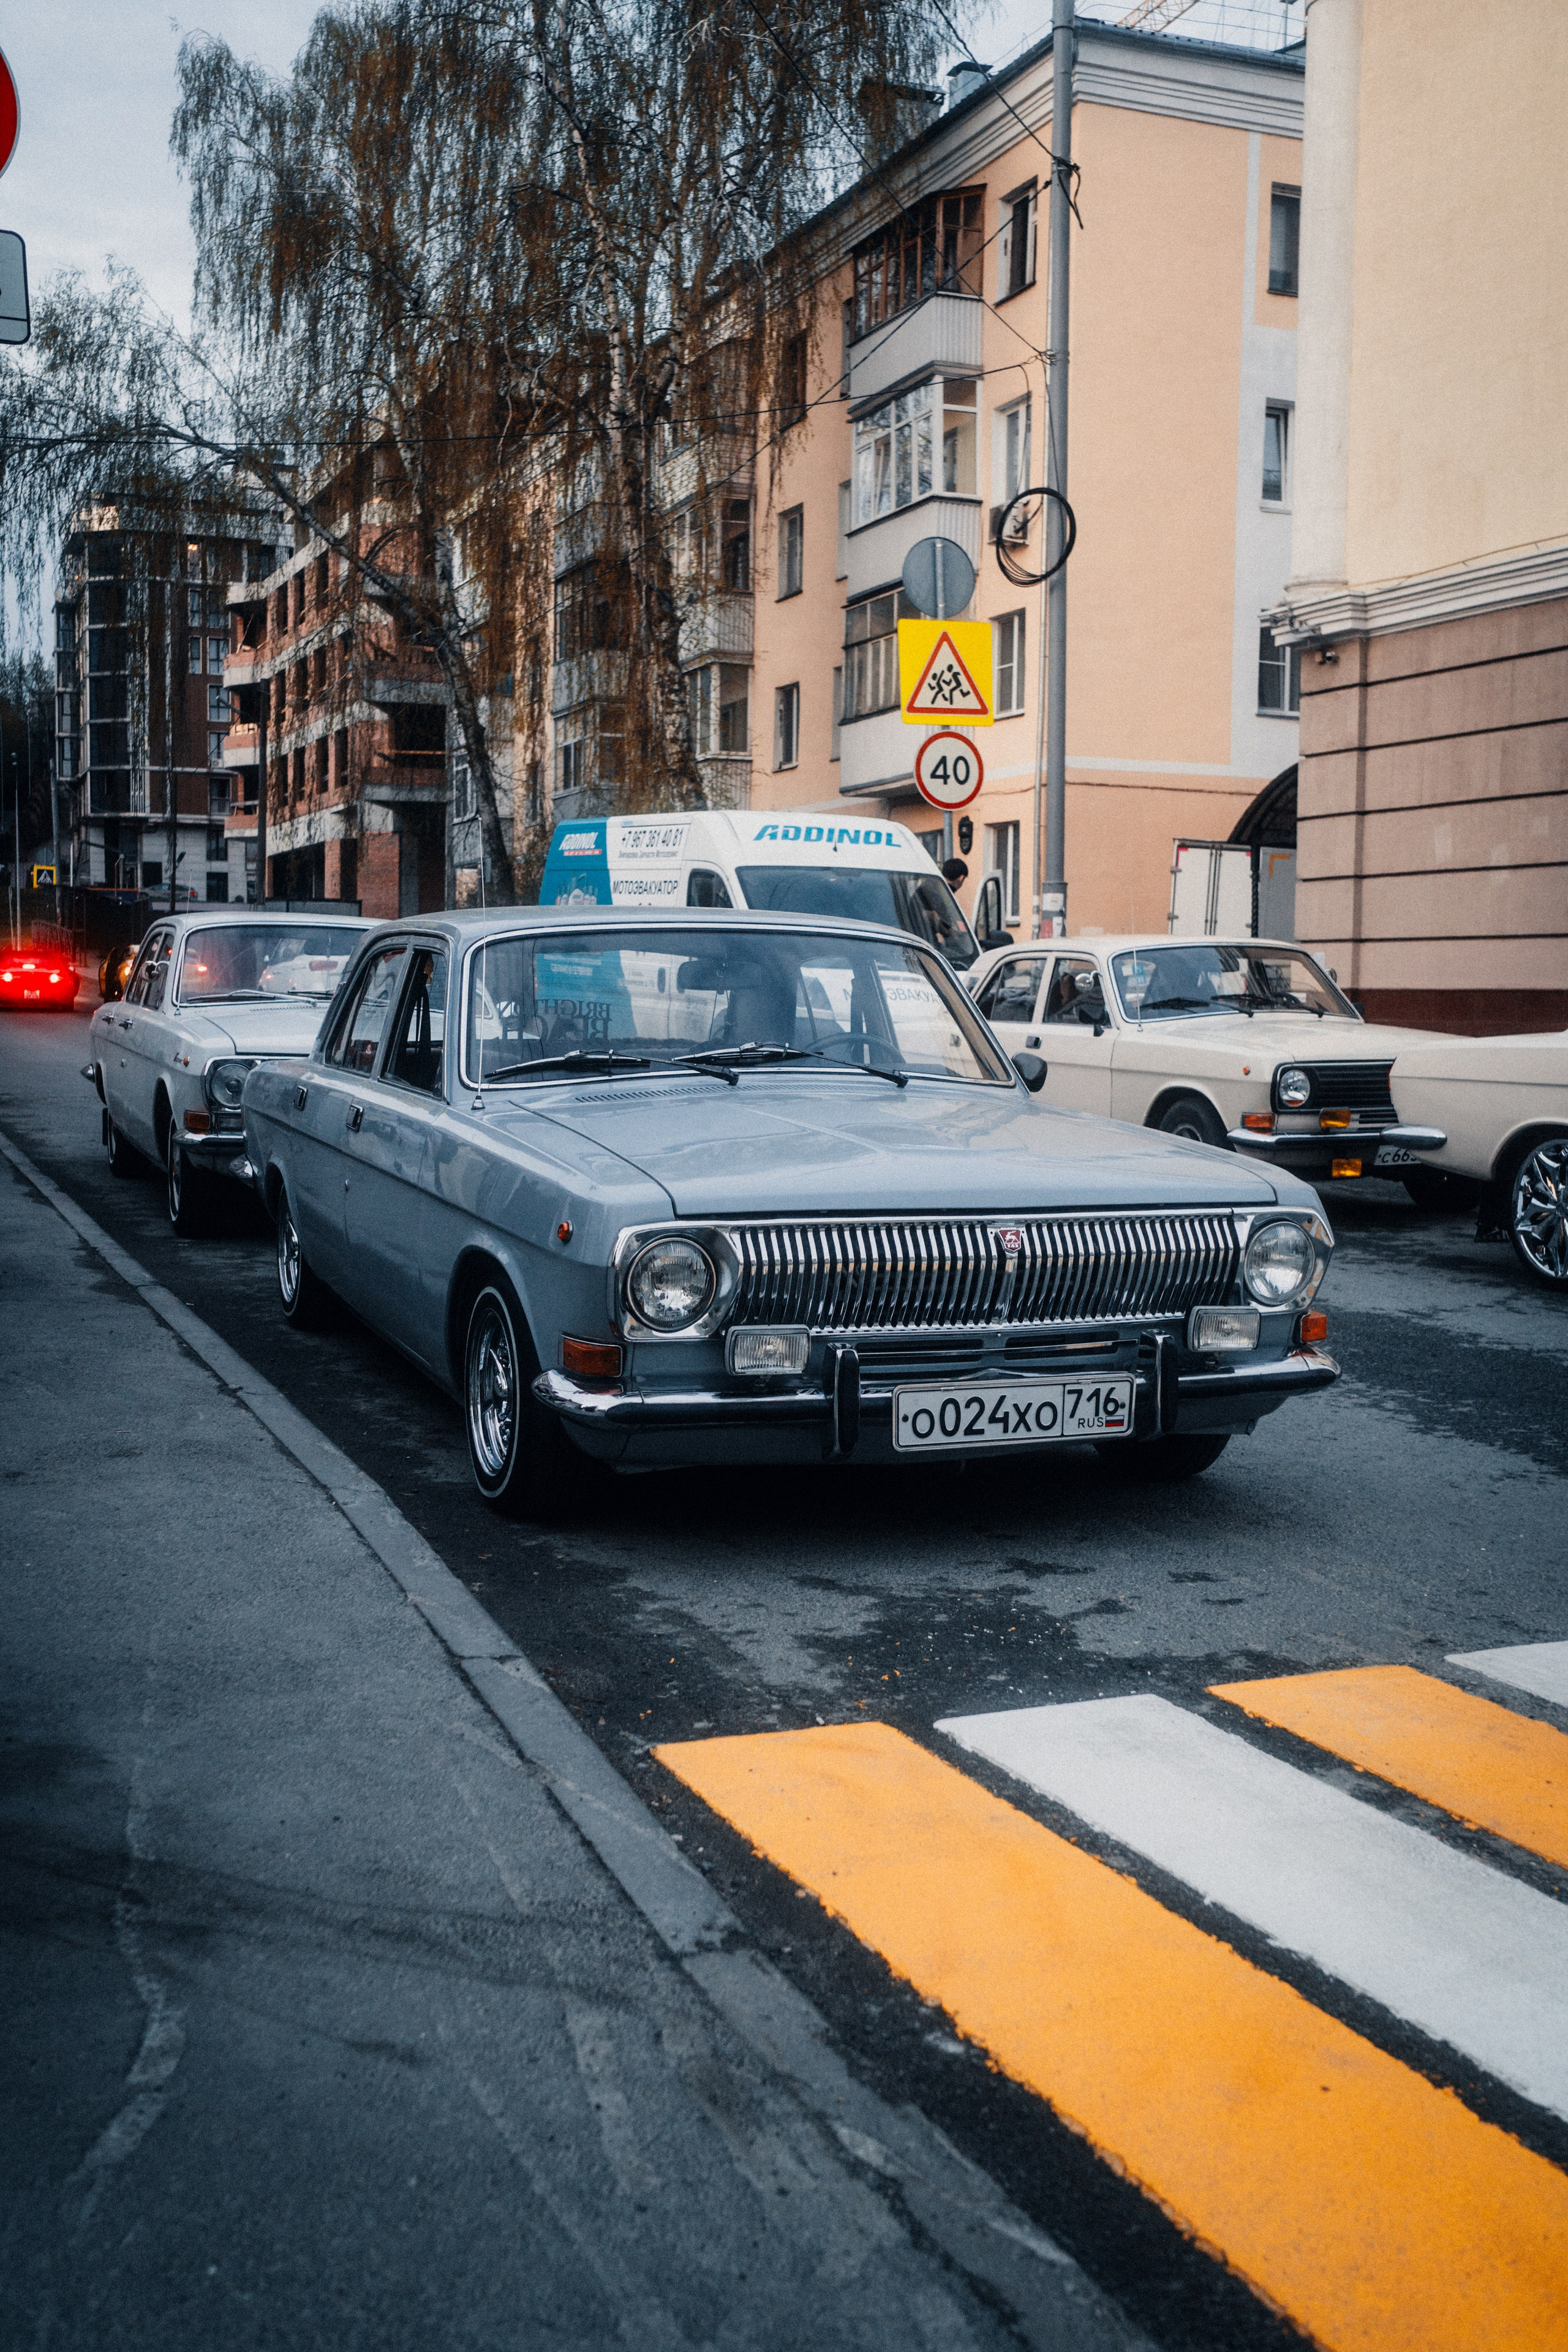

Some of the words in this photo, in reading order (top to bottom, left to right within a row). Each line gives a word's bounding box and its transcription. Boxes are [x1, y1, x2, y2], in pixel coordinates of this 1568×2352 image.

[930, 755, 970, 785] 40
[558, 832, 598, 850] ADDINOL
[753, 824, 902, 848] ADDINOL
[612, 880, 679, 895] МОТОЭВАКУАТОР
[1067, 1387, 1120, 1419] 716
[1077, 1416, 1104, 1429] RUS
